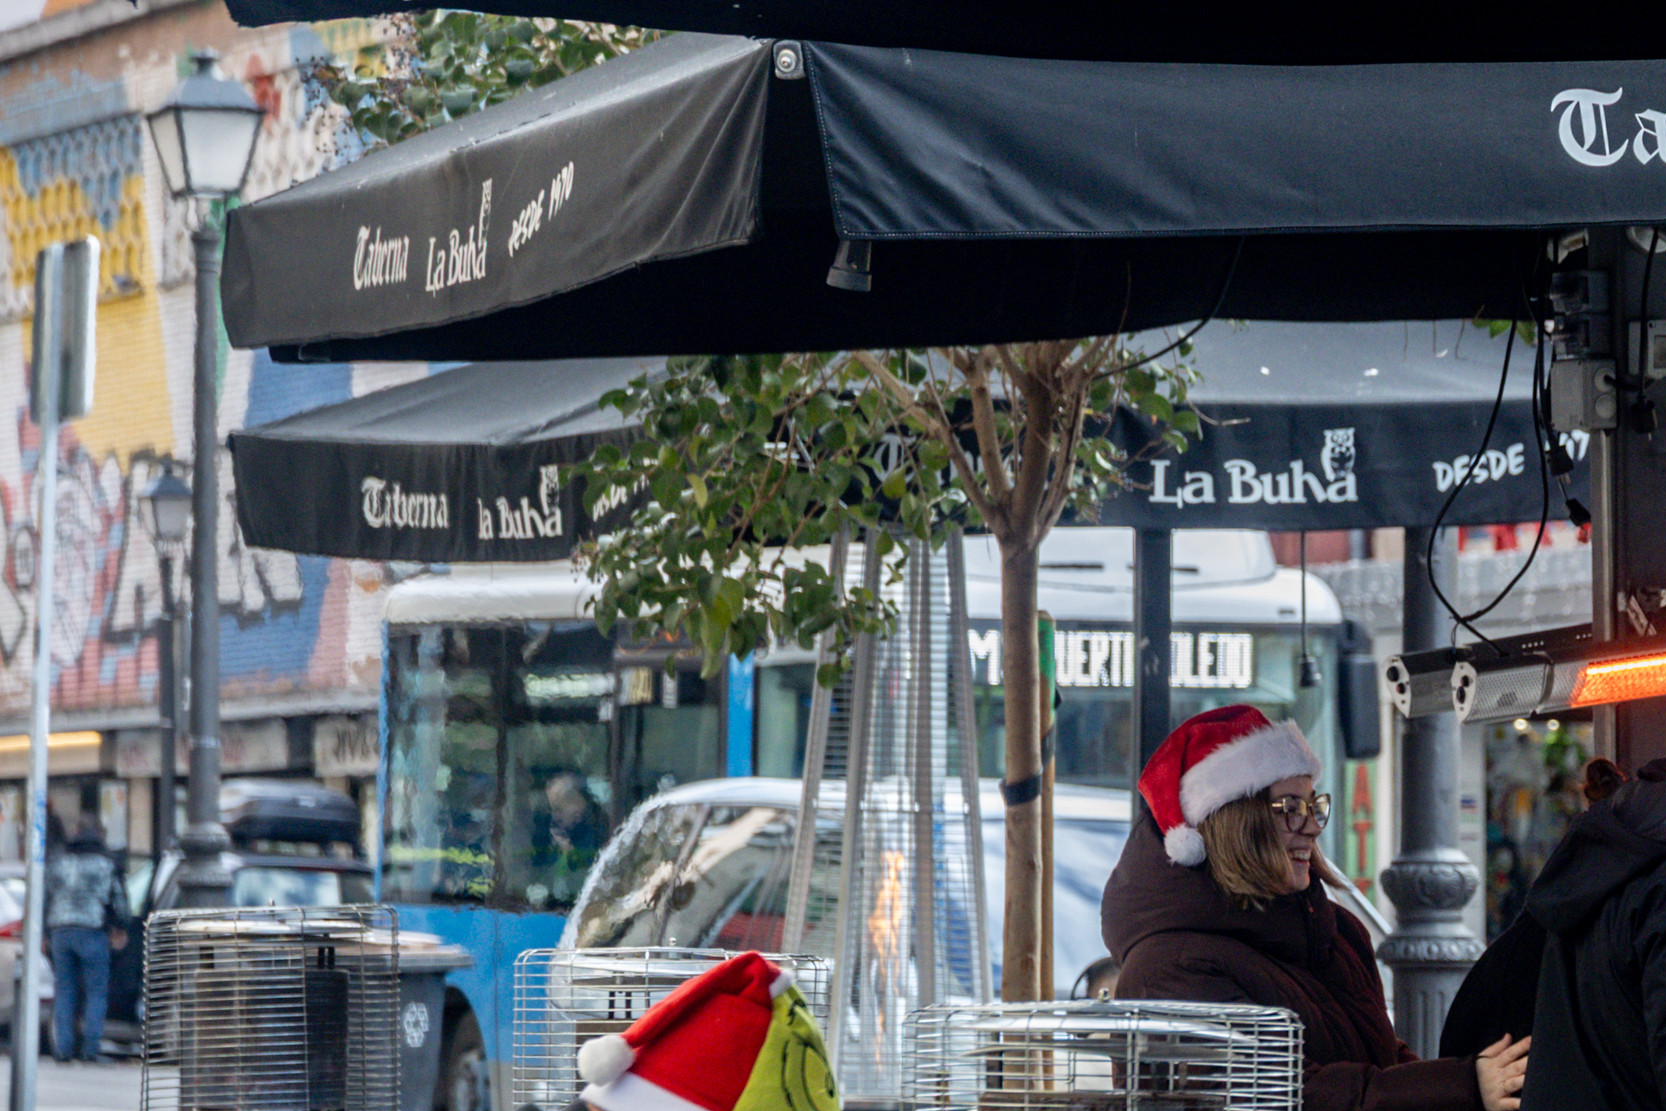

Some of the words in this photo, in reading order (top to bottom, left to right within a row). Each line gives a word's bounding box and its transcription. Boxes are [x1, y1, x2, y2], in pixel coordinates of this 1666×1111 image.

[353, 225, 410, 291] Taberna
[425, 236, 446, 297] La
[508, 188, 546, 259] DESDE
[548, 160, 575, 222] 1970
[1149, 459, 1215, 509] La
[1224, 457, 1359, 505] Buha
[1432, 443, 1526, 492] DESDE
[1169, 632, 1254, 688] OLEDO
